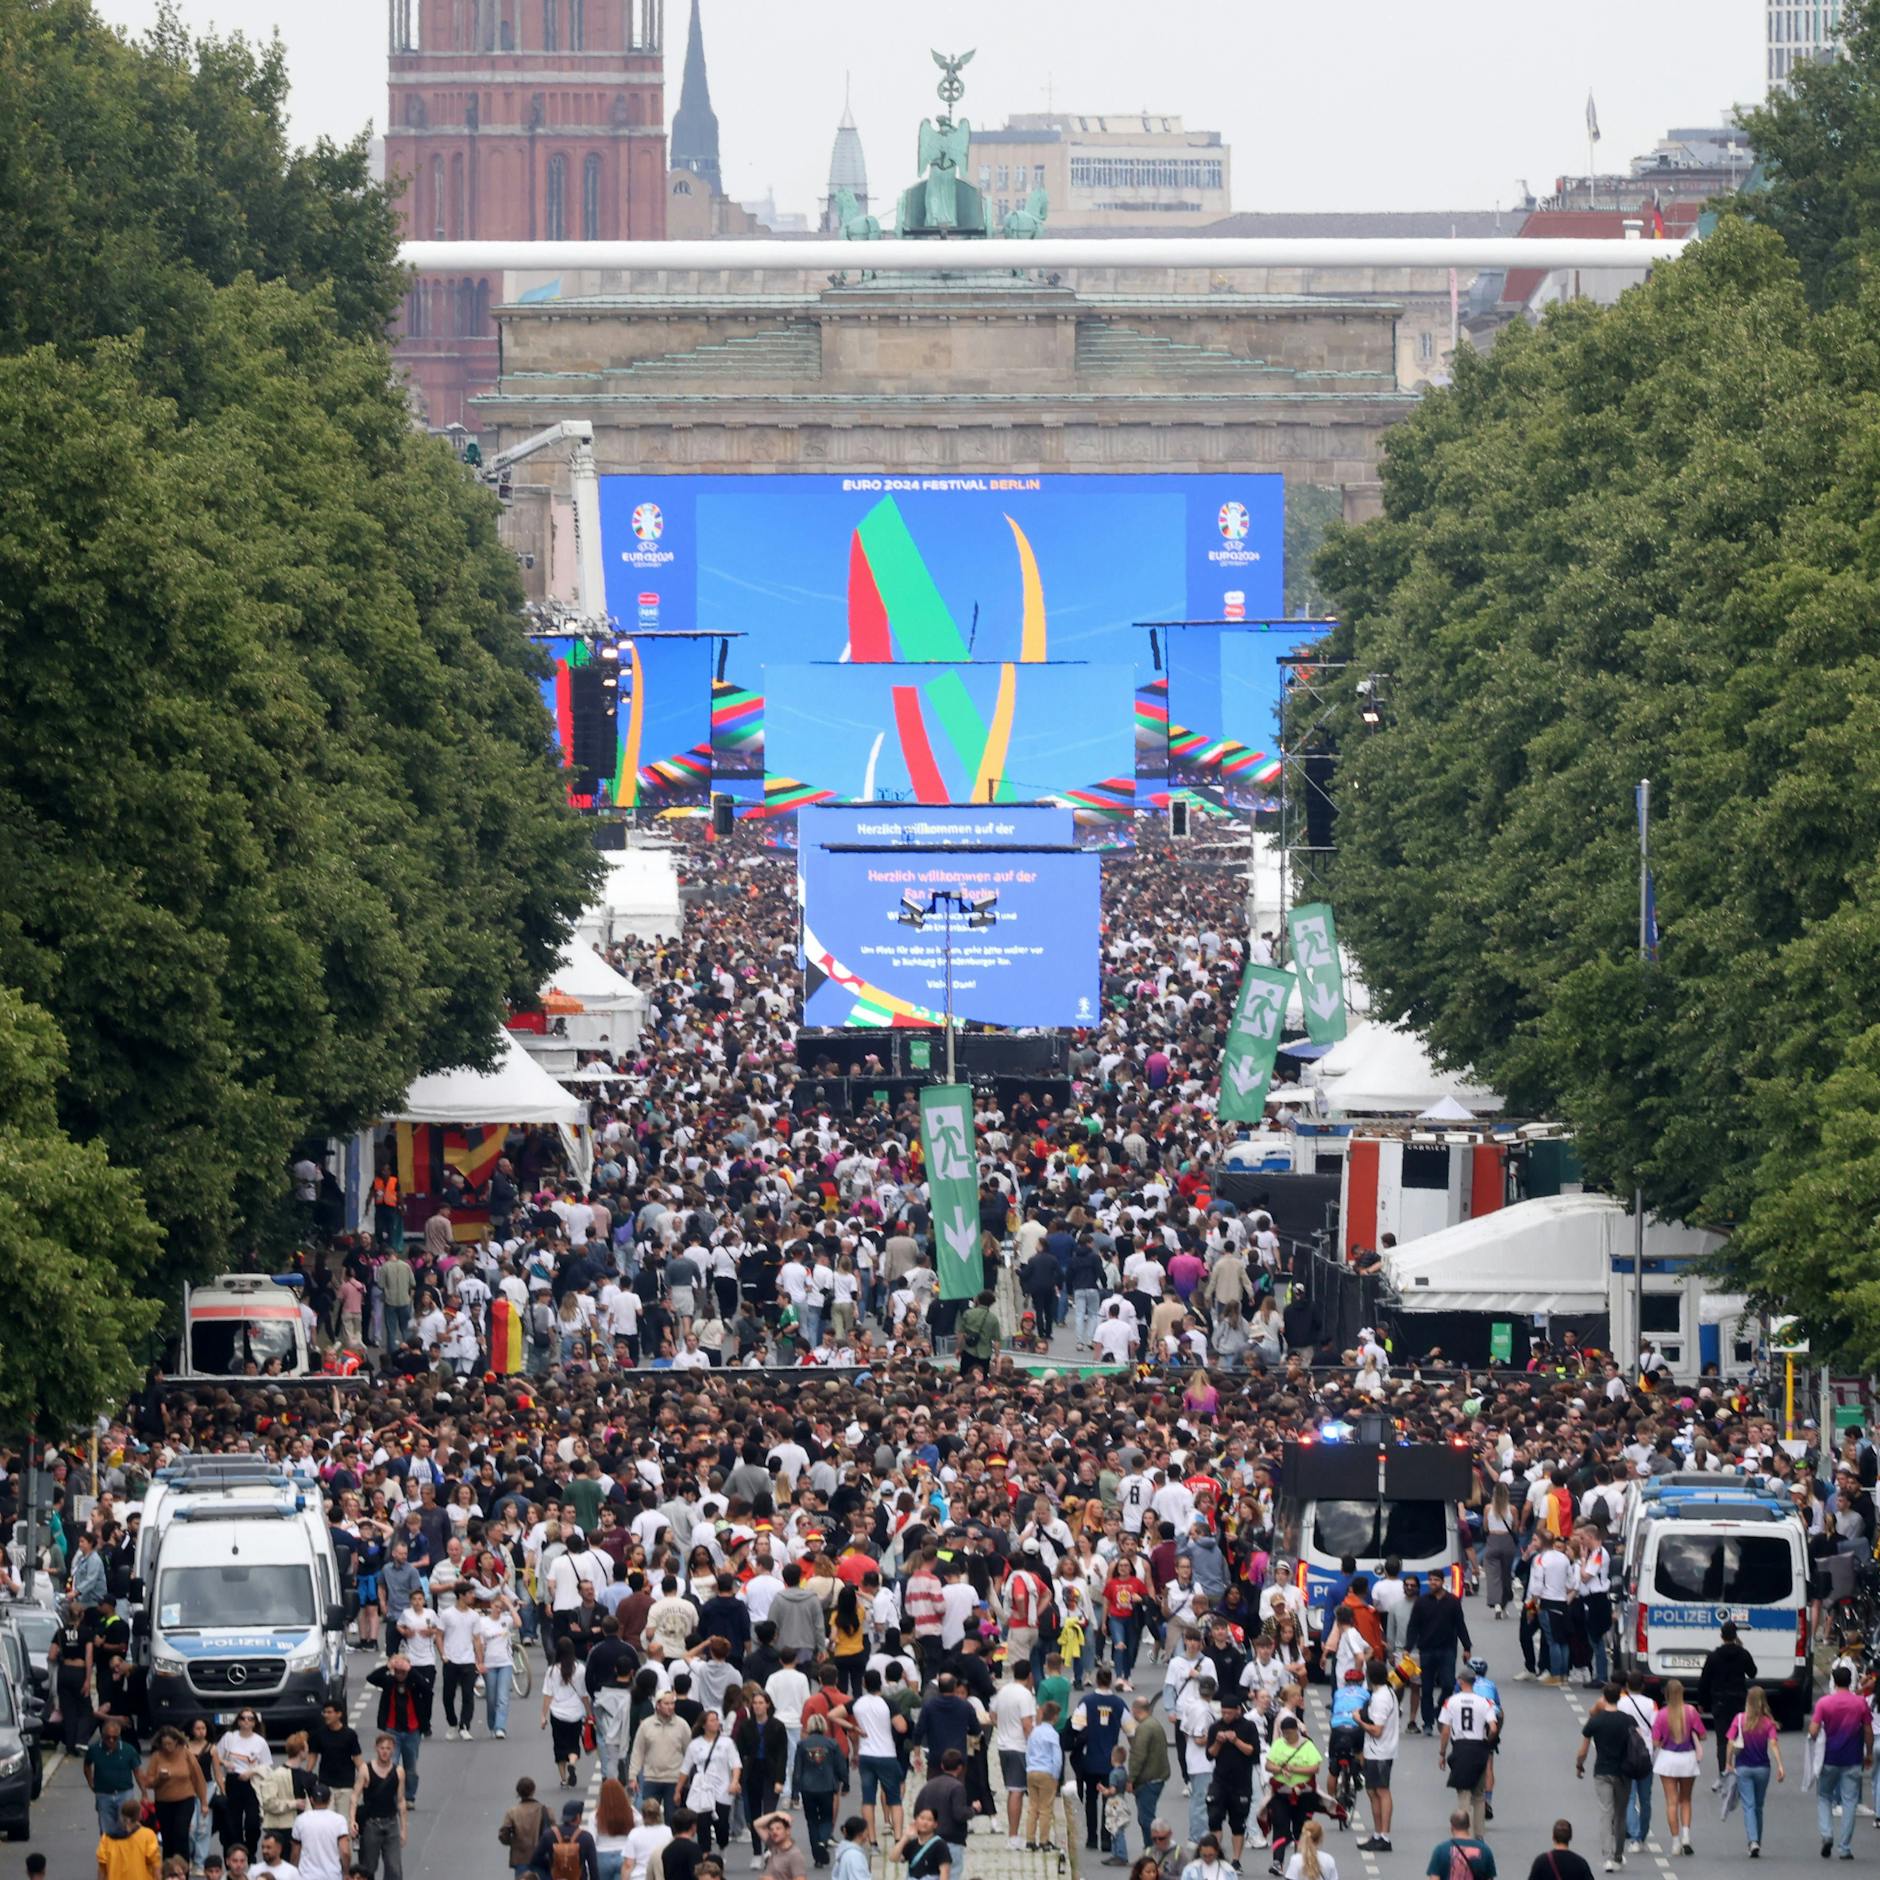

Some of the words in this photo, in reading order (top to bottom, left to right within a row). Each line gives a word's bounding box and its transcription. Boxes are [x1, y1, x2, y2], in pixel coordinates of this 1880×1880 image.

[842, 479, 882, 491] EURO
[884, 479, 920, 491] 2024
[922, 479, 987, 490] FESTIVAL
[990, 479, 1040, 490] BERLIN
[857, 823, 902, 835] Herzlich
[903, 823, 973, 835] willkommen
[975, 823, 993, 835] auf
[995, 823, 1015, 835] der
[868, 870, 916, 882] Herzlich
[918, 869, 991, 882] willkommen
[993, 870, 1015, 882] auf
[1016, 870, 1037, 882] der
[1130, 1485, 1140, 1505] 8
[1654, 1609, 1712, 1624] POLIZEI
[65, 1629, 79, 1641] 10
[201, 1637, 272, 1649] POLIZEI
[1461, 1706, 1473, 1731] 8
